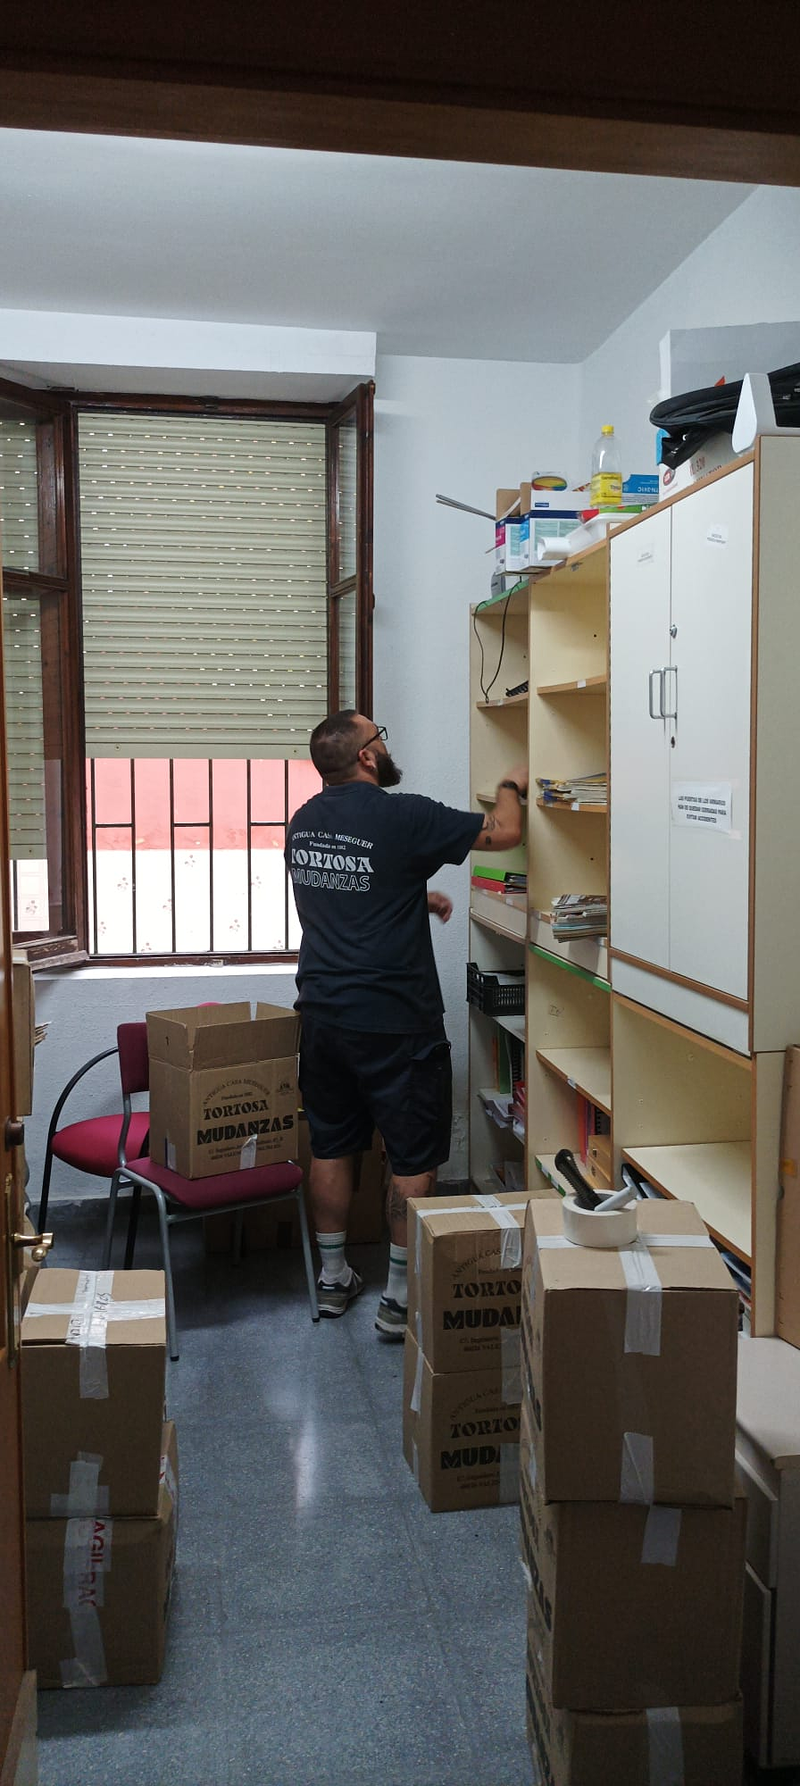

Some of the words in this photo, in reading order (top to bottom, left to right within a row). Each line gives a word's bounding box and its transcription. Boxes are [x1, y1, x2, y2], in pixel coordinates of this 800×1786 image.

[335, 832, 374, 850] MESEGUER
[203, 1099, 269, 1121] TORTOSA
[197, 1114, 294, 1145] MUDANZAS
